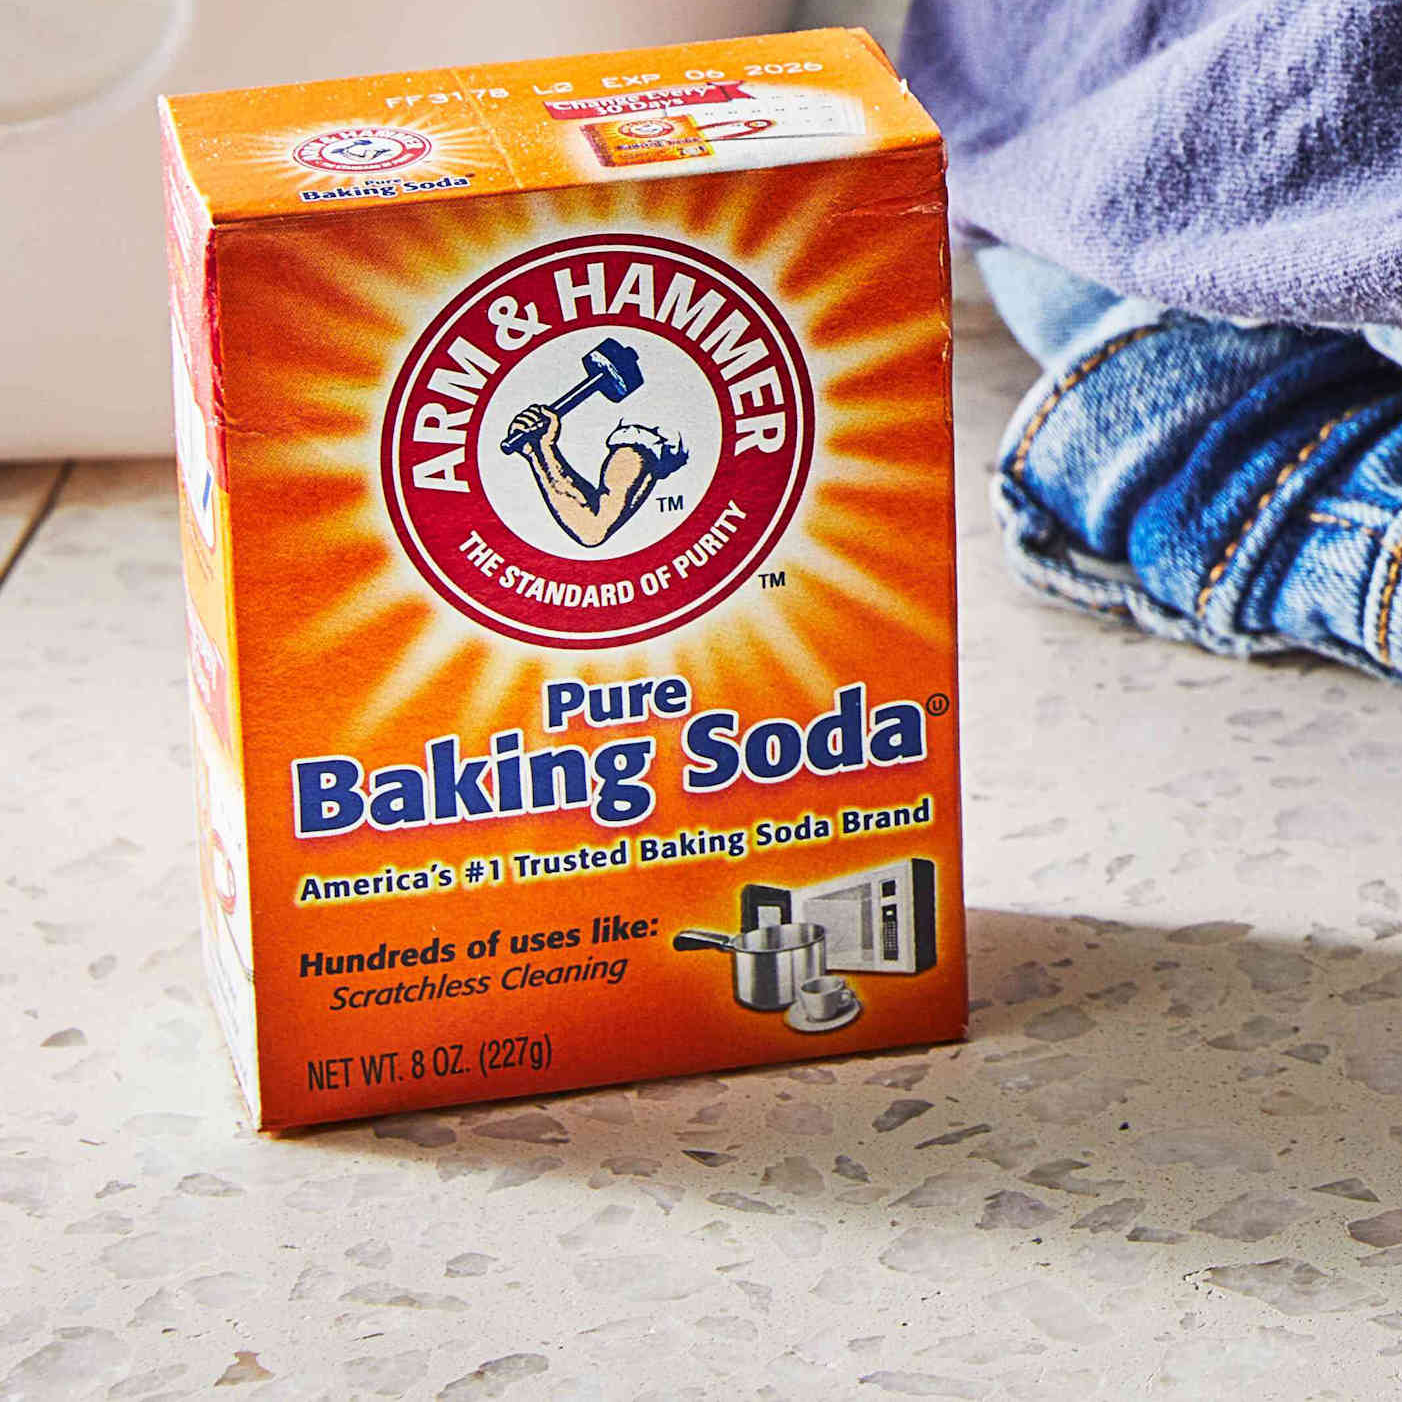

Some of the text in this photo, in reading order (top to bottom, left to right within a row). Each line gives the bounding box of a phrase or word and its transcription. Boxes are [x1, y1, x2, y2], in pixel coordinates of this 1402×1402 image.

[601, 72, 660, 89] EXP
[684, 69, 725, 81] 06
[744, 61, 824, 77] 2026
[302, 177, 469, 201] Baking Soda
[412, 262, 787, 494] ARM & HAMMER
[656, 496, 685, 514] TM
[458, 499, 748, 609] THE STANDARD OF PURITY
[758, 572, 786, 590] TM
[546, 677, 688, 729] Pure
[296, 686, 925, 833] Baking Soda
[300, 798, 931, 901] America's #1 Trusted Baking Soda Brand
[299, 914, 660, 977] Hundreds of uses like:
[328, 955, 628, 1011] Scratchless Cleaning
[307, 1033, 553, 1091] NET WT. 8 OZ. (227g)
